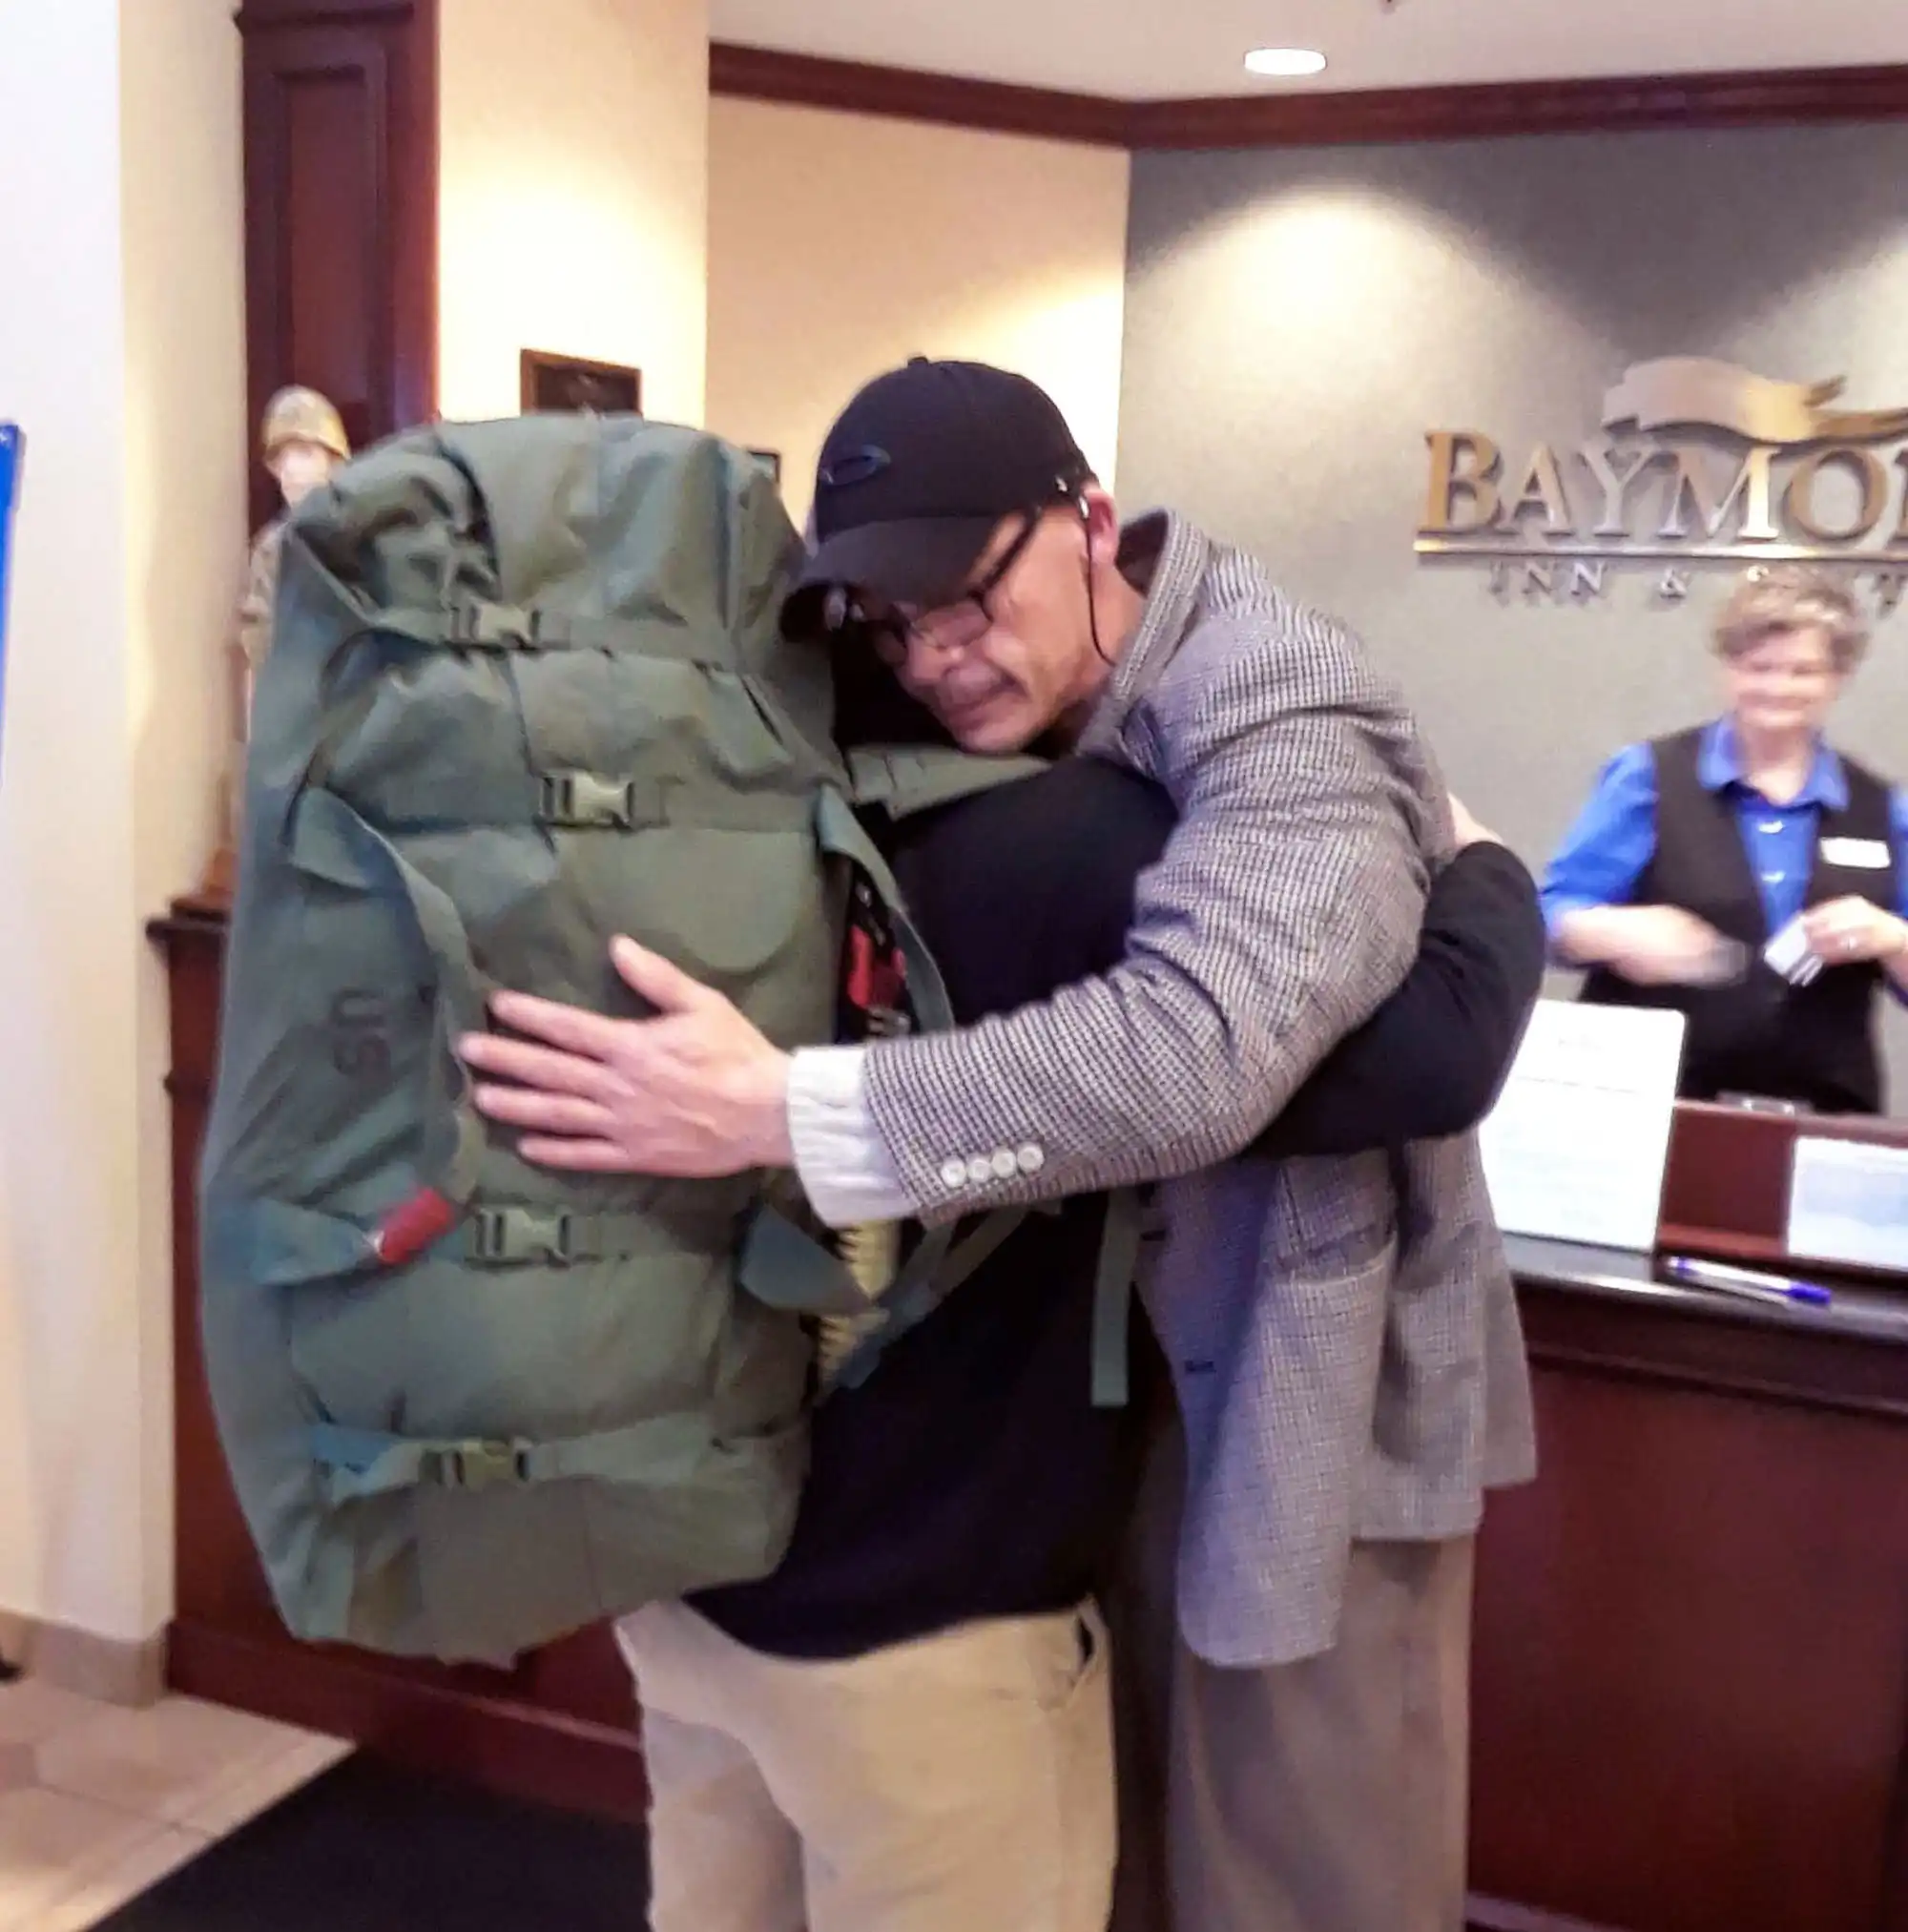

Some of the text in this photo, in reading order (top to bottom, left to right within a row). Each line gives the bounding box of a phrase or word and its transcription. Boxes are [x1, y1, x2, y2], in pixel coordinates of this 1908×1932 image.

[1418, 431, 1908, 542] BAYMO
[1488, 558, 1692, 599] INN &
